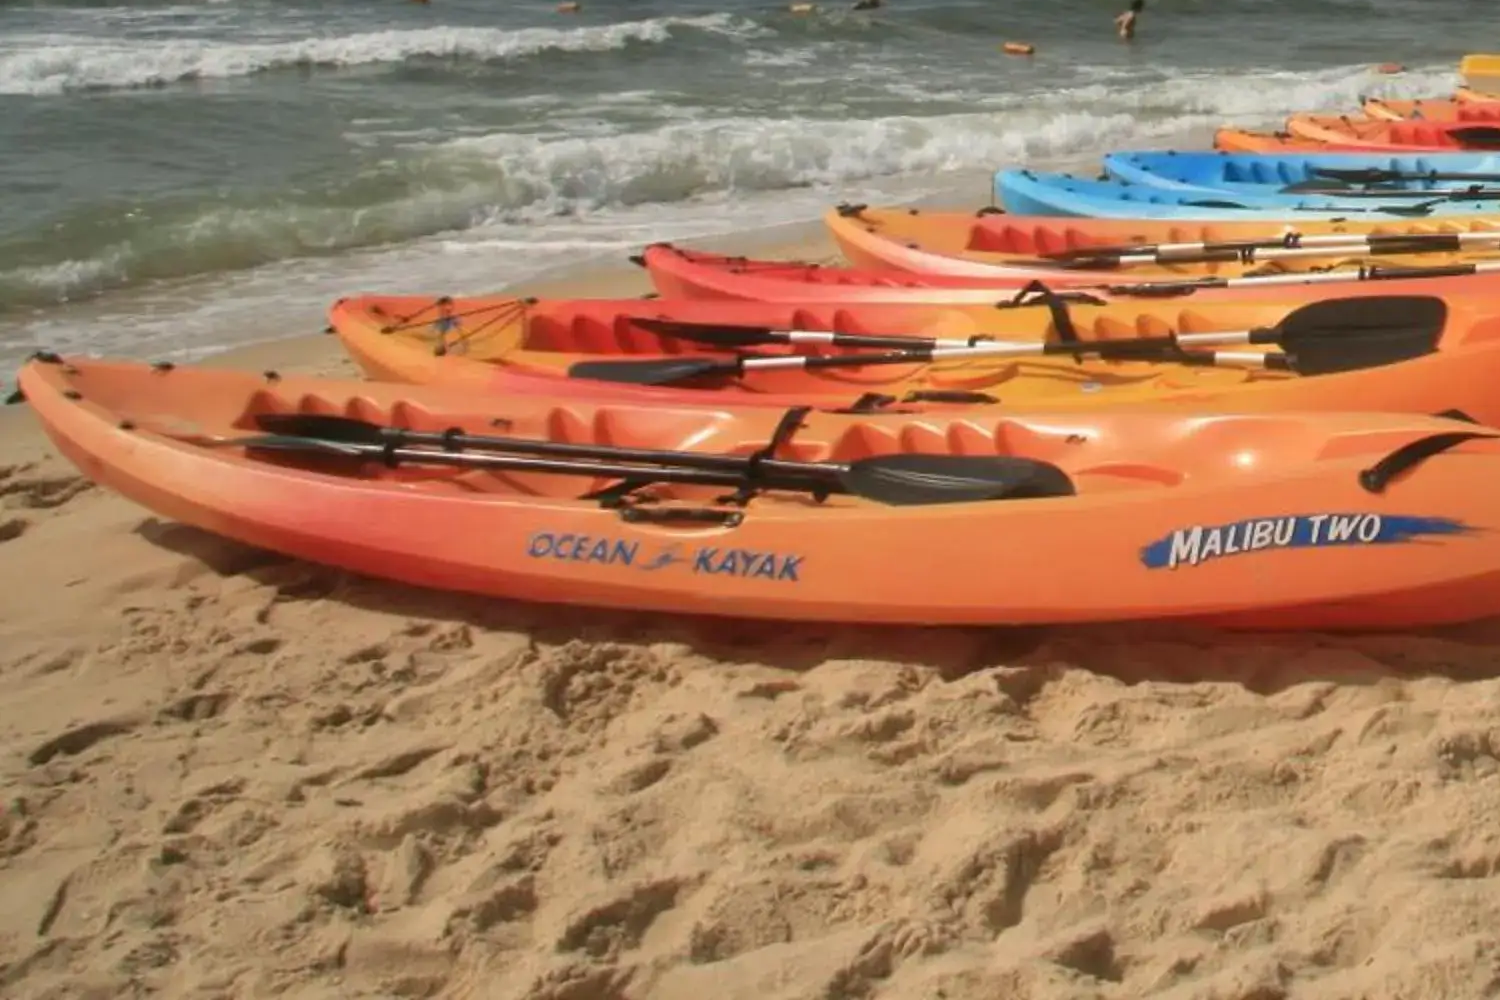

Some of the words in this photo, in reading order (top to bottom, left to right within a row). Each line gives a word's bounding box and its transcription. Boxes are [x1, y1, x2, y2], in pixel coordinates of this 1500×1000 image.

[528, 533, 638, 566] OCEAN
[694, 546, 804, 581] KAYAK
[1168, 517, 1294, 568] MALIBU
[1308, 514, 1381, 543] TWO
